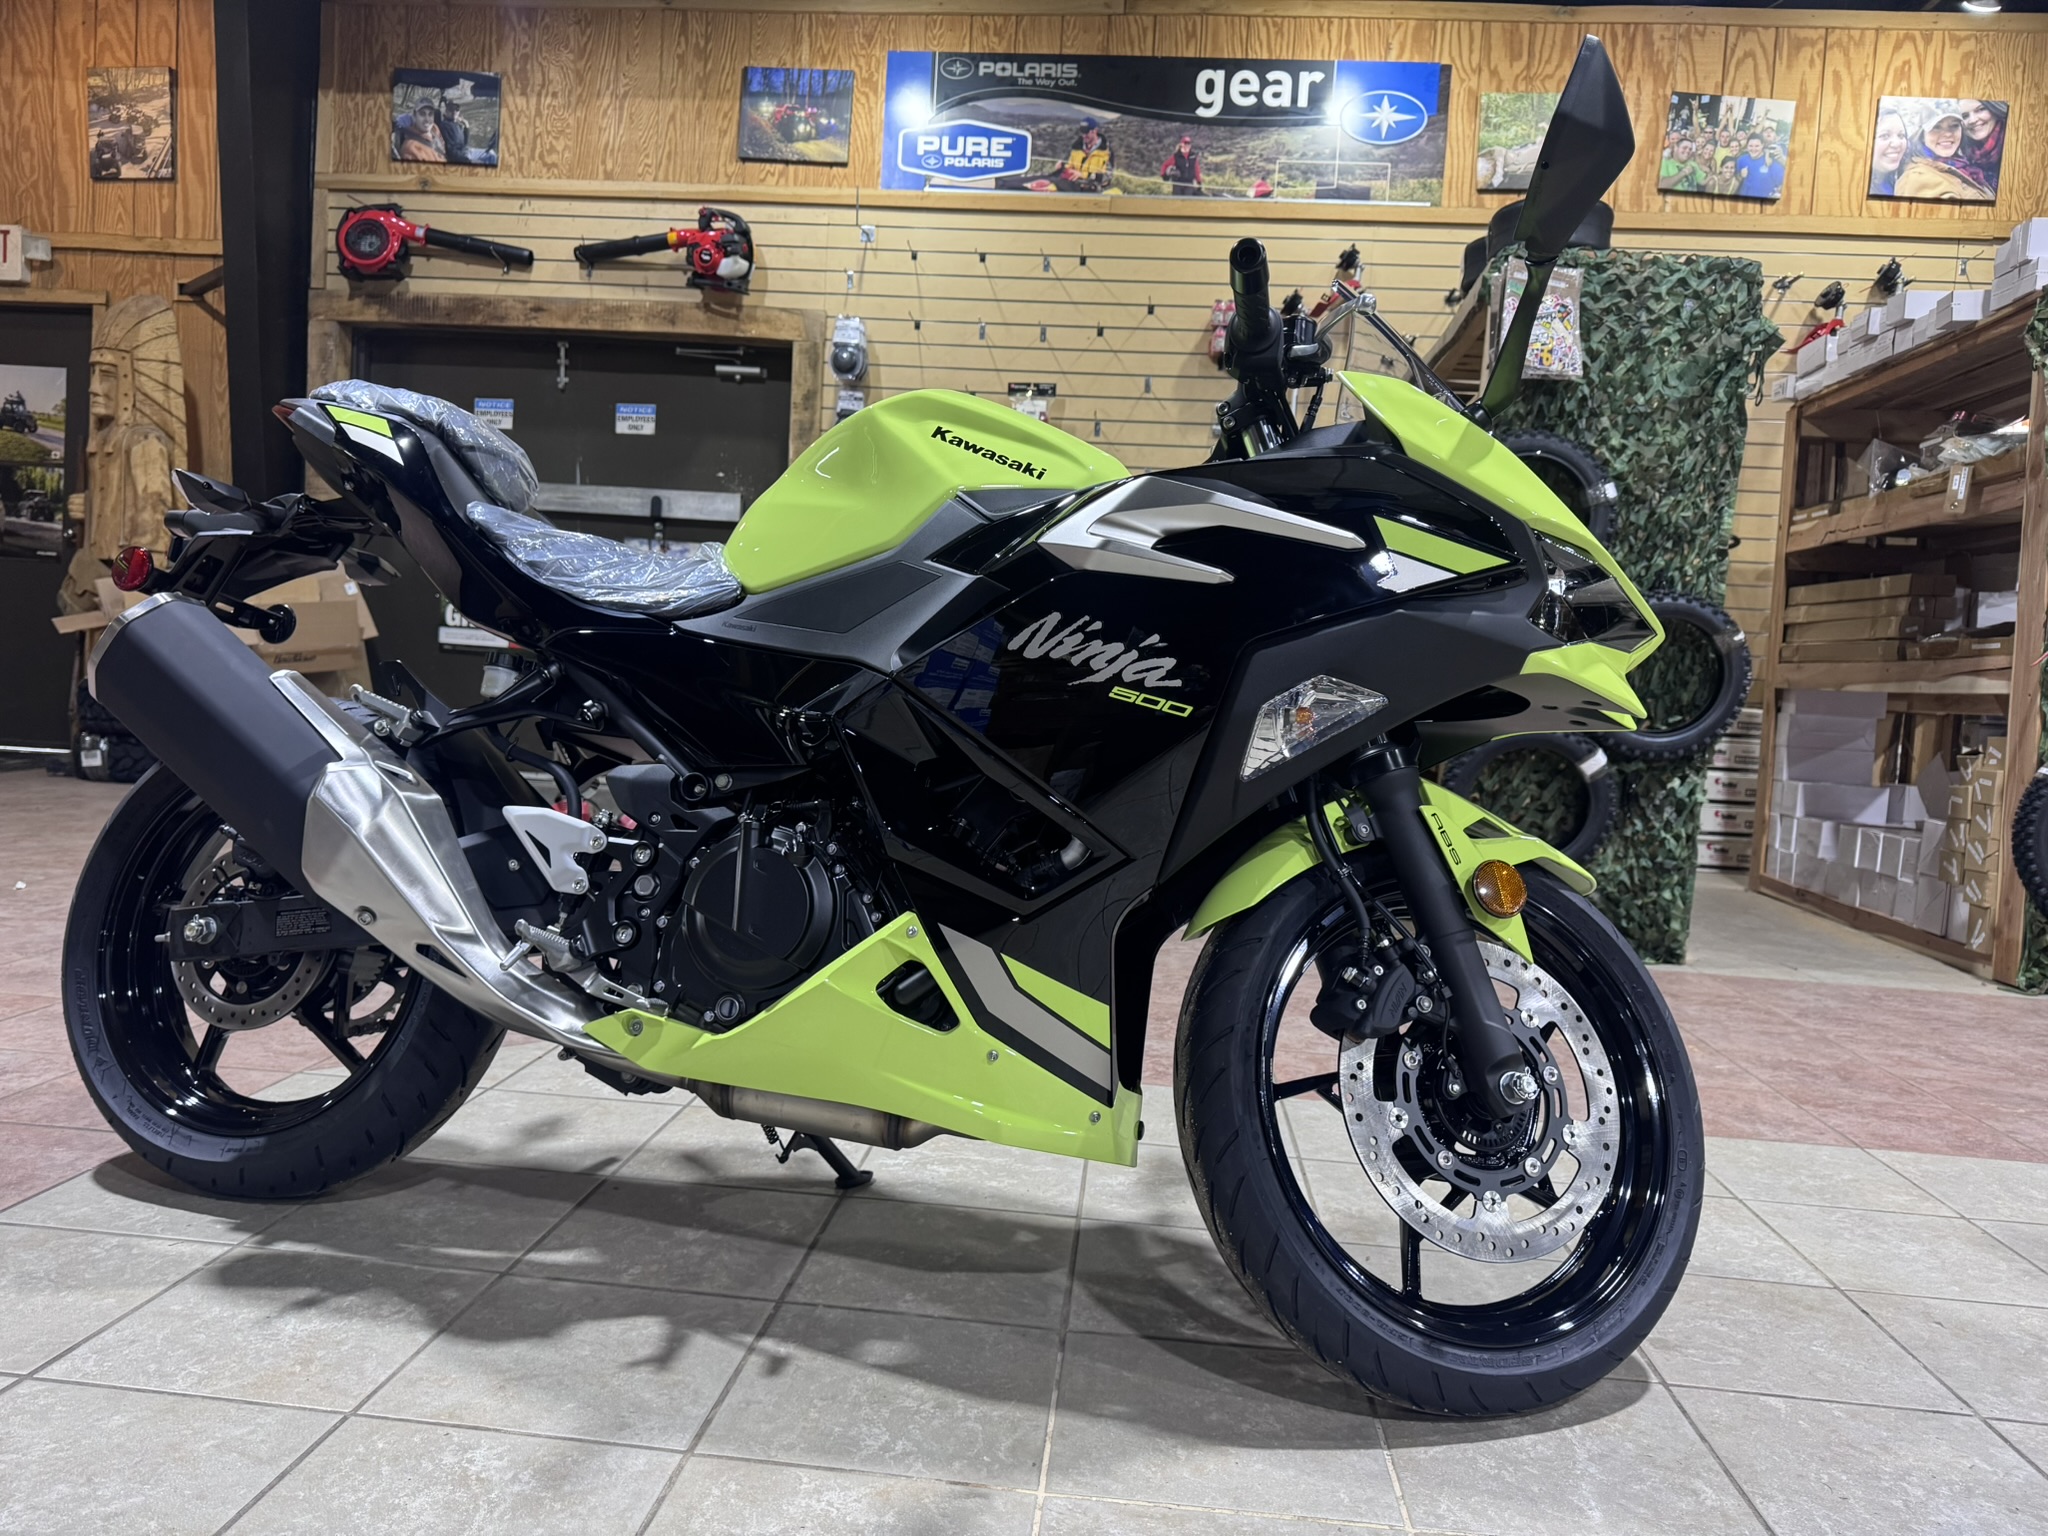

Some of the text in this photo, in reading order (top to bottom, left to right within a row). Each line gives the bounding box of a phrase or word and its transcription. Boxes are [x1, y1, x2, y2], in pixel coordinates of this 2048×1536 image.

[978, 61, 1078, 78] POLARIS
[1017, 77, 1033, 86] The
[1035, 78, 1056, 88] Way
[1195, 69, 1326, 118] gear
[916, 135, 1013, 158] PURE
[943, 156, 1005, 169] POLARIS
[478, 400, 511, 409] NOTICE
[619, 406, 653, 414] NOTICE
[617, 415, 656, 423] EMPLOYEES
[931, 425, 1048, 481] Kawasaki
[1007, 611, 1183, 688] Ninja
[1108, 686, 1194, 717] 500
[1431, 813, 1462, 866] ABS
